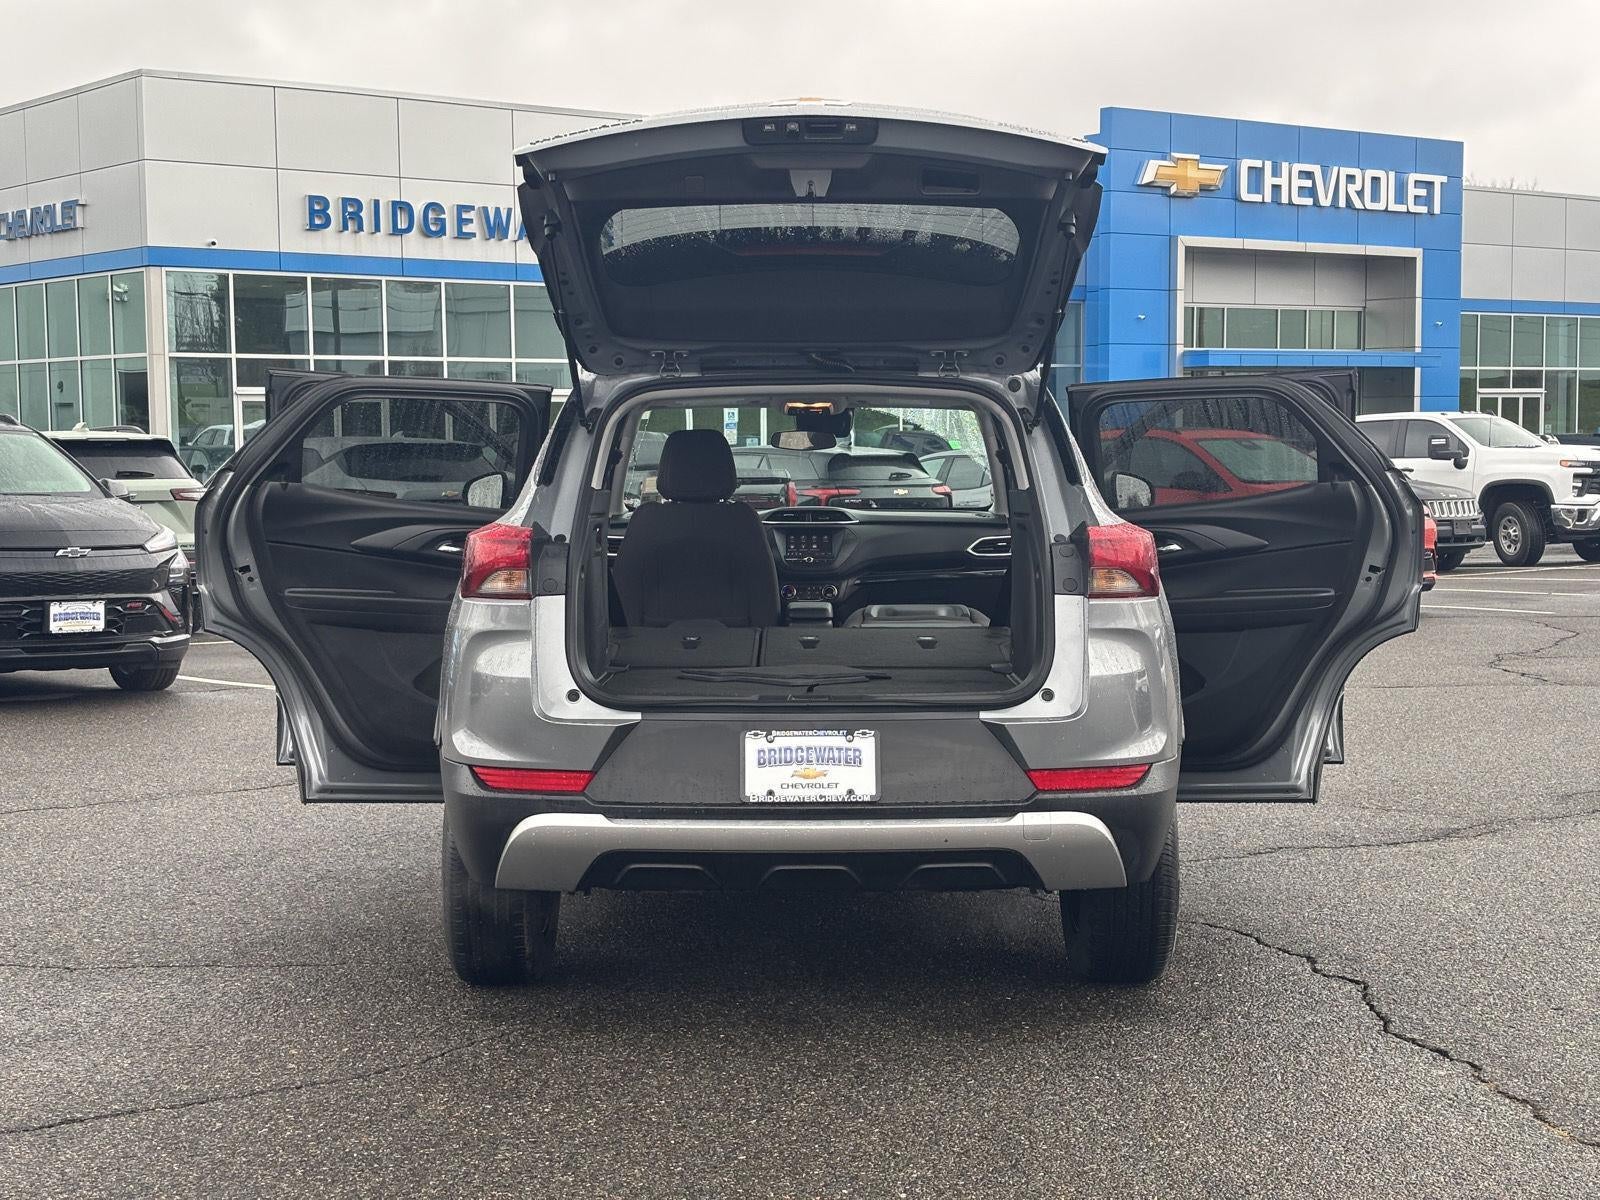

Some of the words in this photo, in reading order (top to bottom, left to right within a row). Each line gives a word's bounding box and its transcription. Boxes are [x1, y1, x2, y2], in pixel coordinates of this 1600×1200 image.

[1239, 158, 1448, 214] CHEVROLET
[305, 194, 527, 241] BRIDGEW
[757, 746, 862, 768] BRIDGEWATER
[780, 782, 840, 790] CHEVROLET
